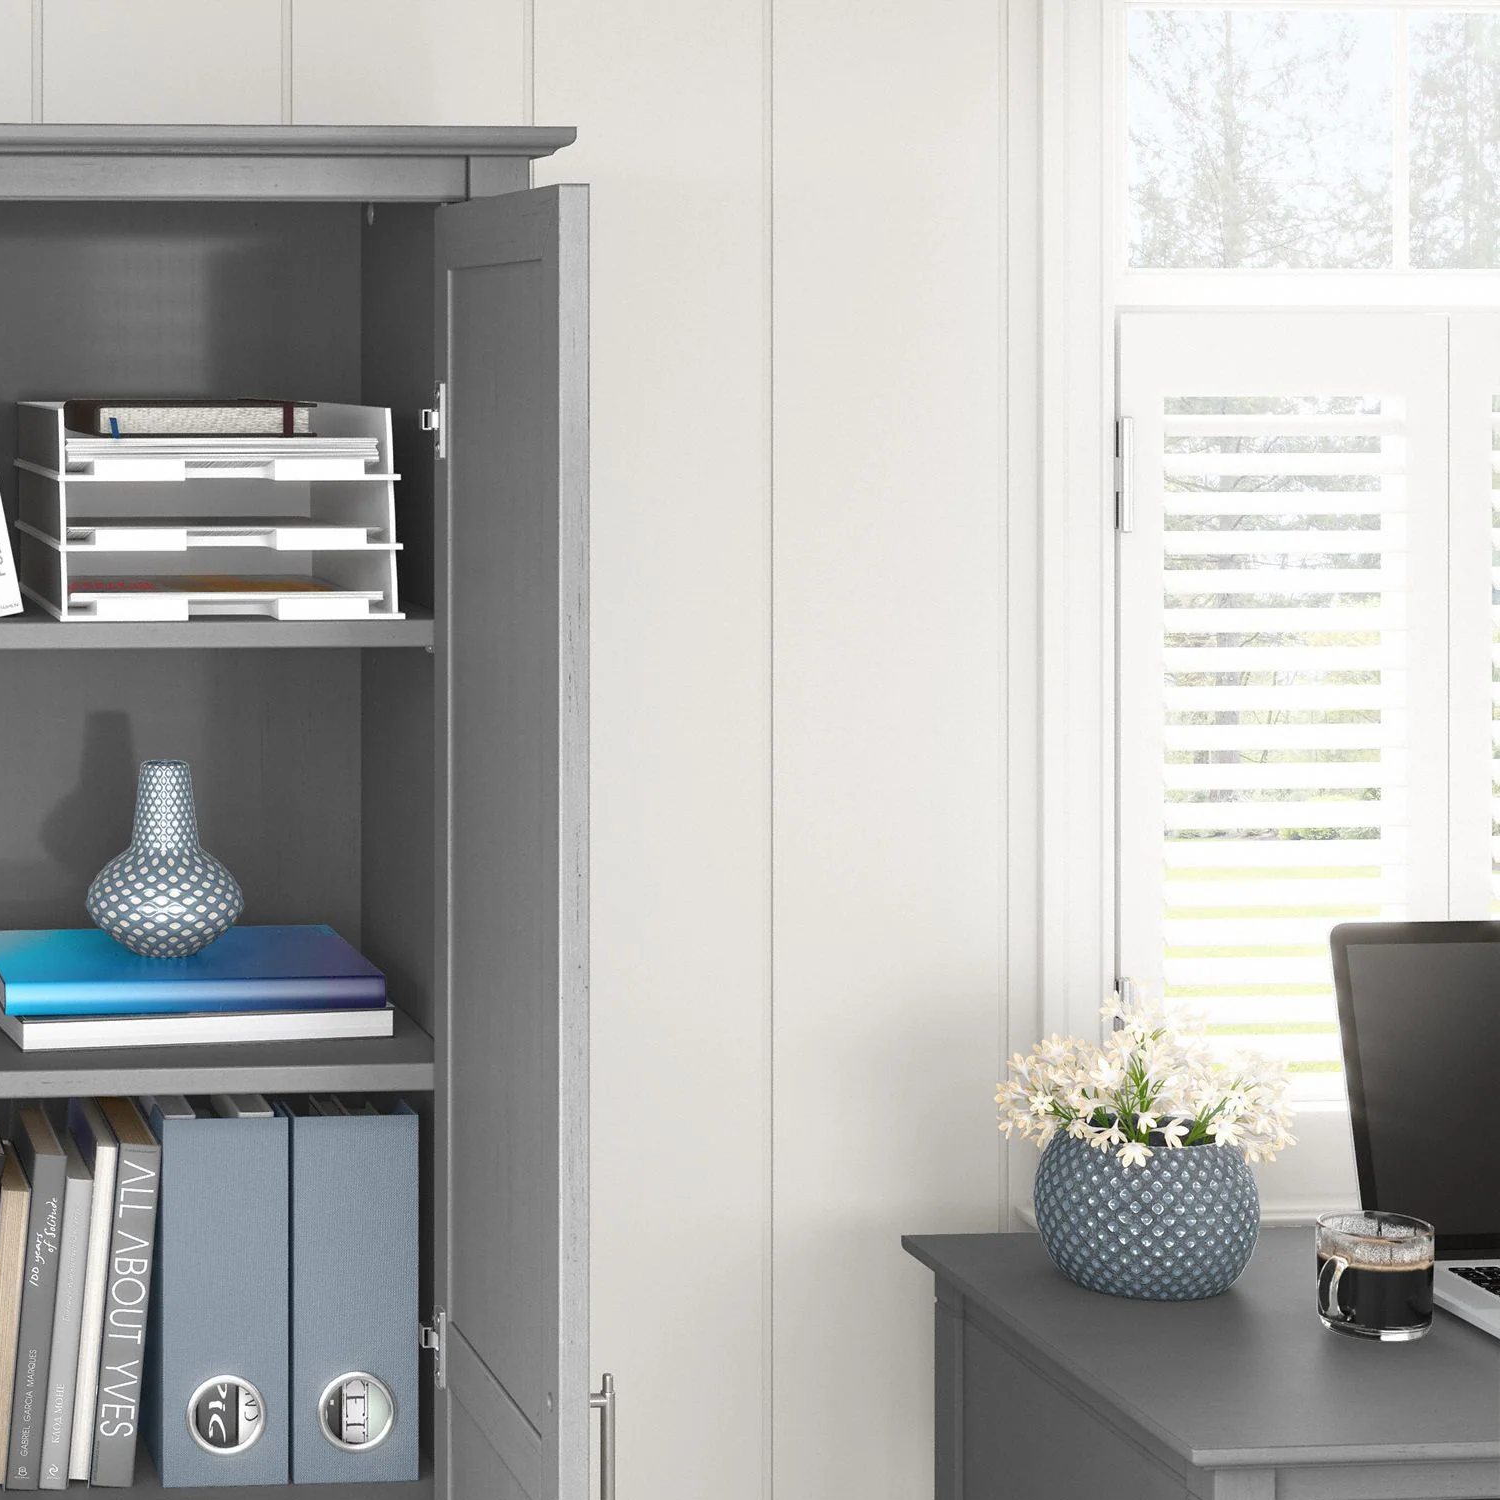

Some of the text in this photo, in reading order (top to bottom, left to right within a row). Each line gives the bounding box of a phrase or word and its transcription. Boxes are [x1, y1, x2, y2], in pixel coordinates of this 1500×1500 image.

[119, 1159, 156, 1218] ALL
[34, 1232, 45, 1265] years
[43, 1197, 58, 1253] of Solitude
[109, 1230, 150, 1345] ABOUT
[20, 1349, 37, 1457] GABRIEL GARCIA MARQUES
[100, 1359, 140, 1438] YVES
